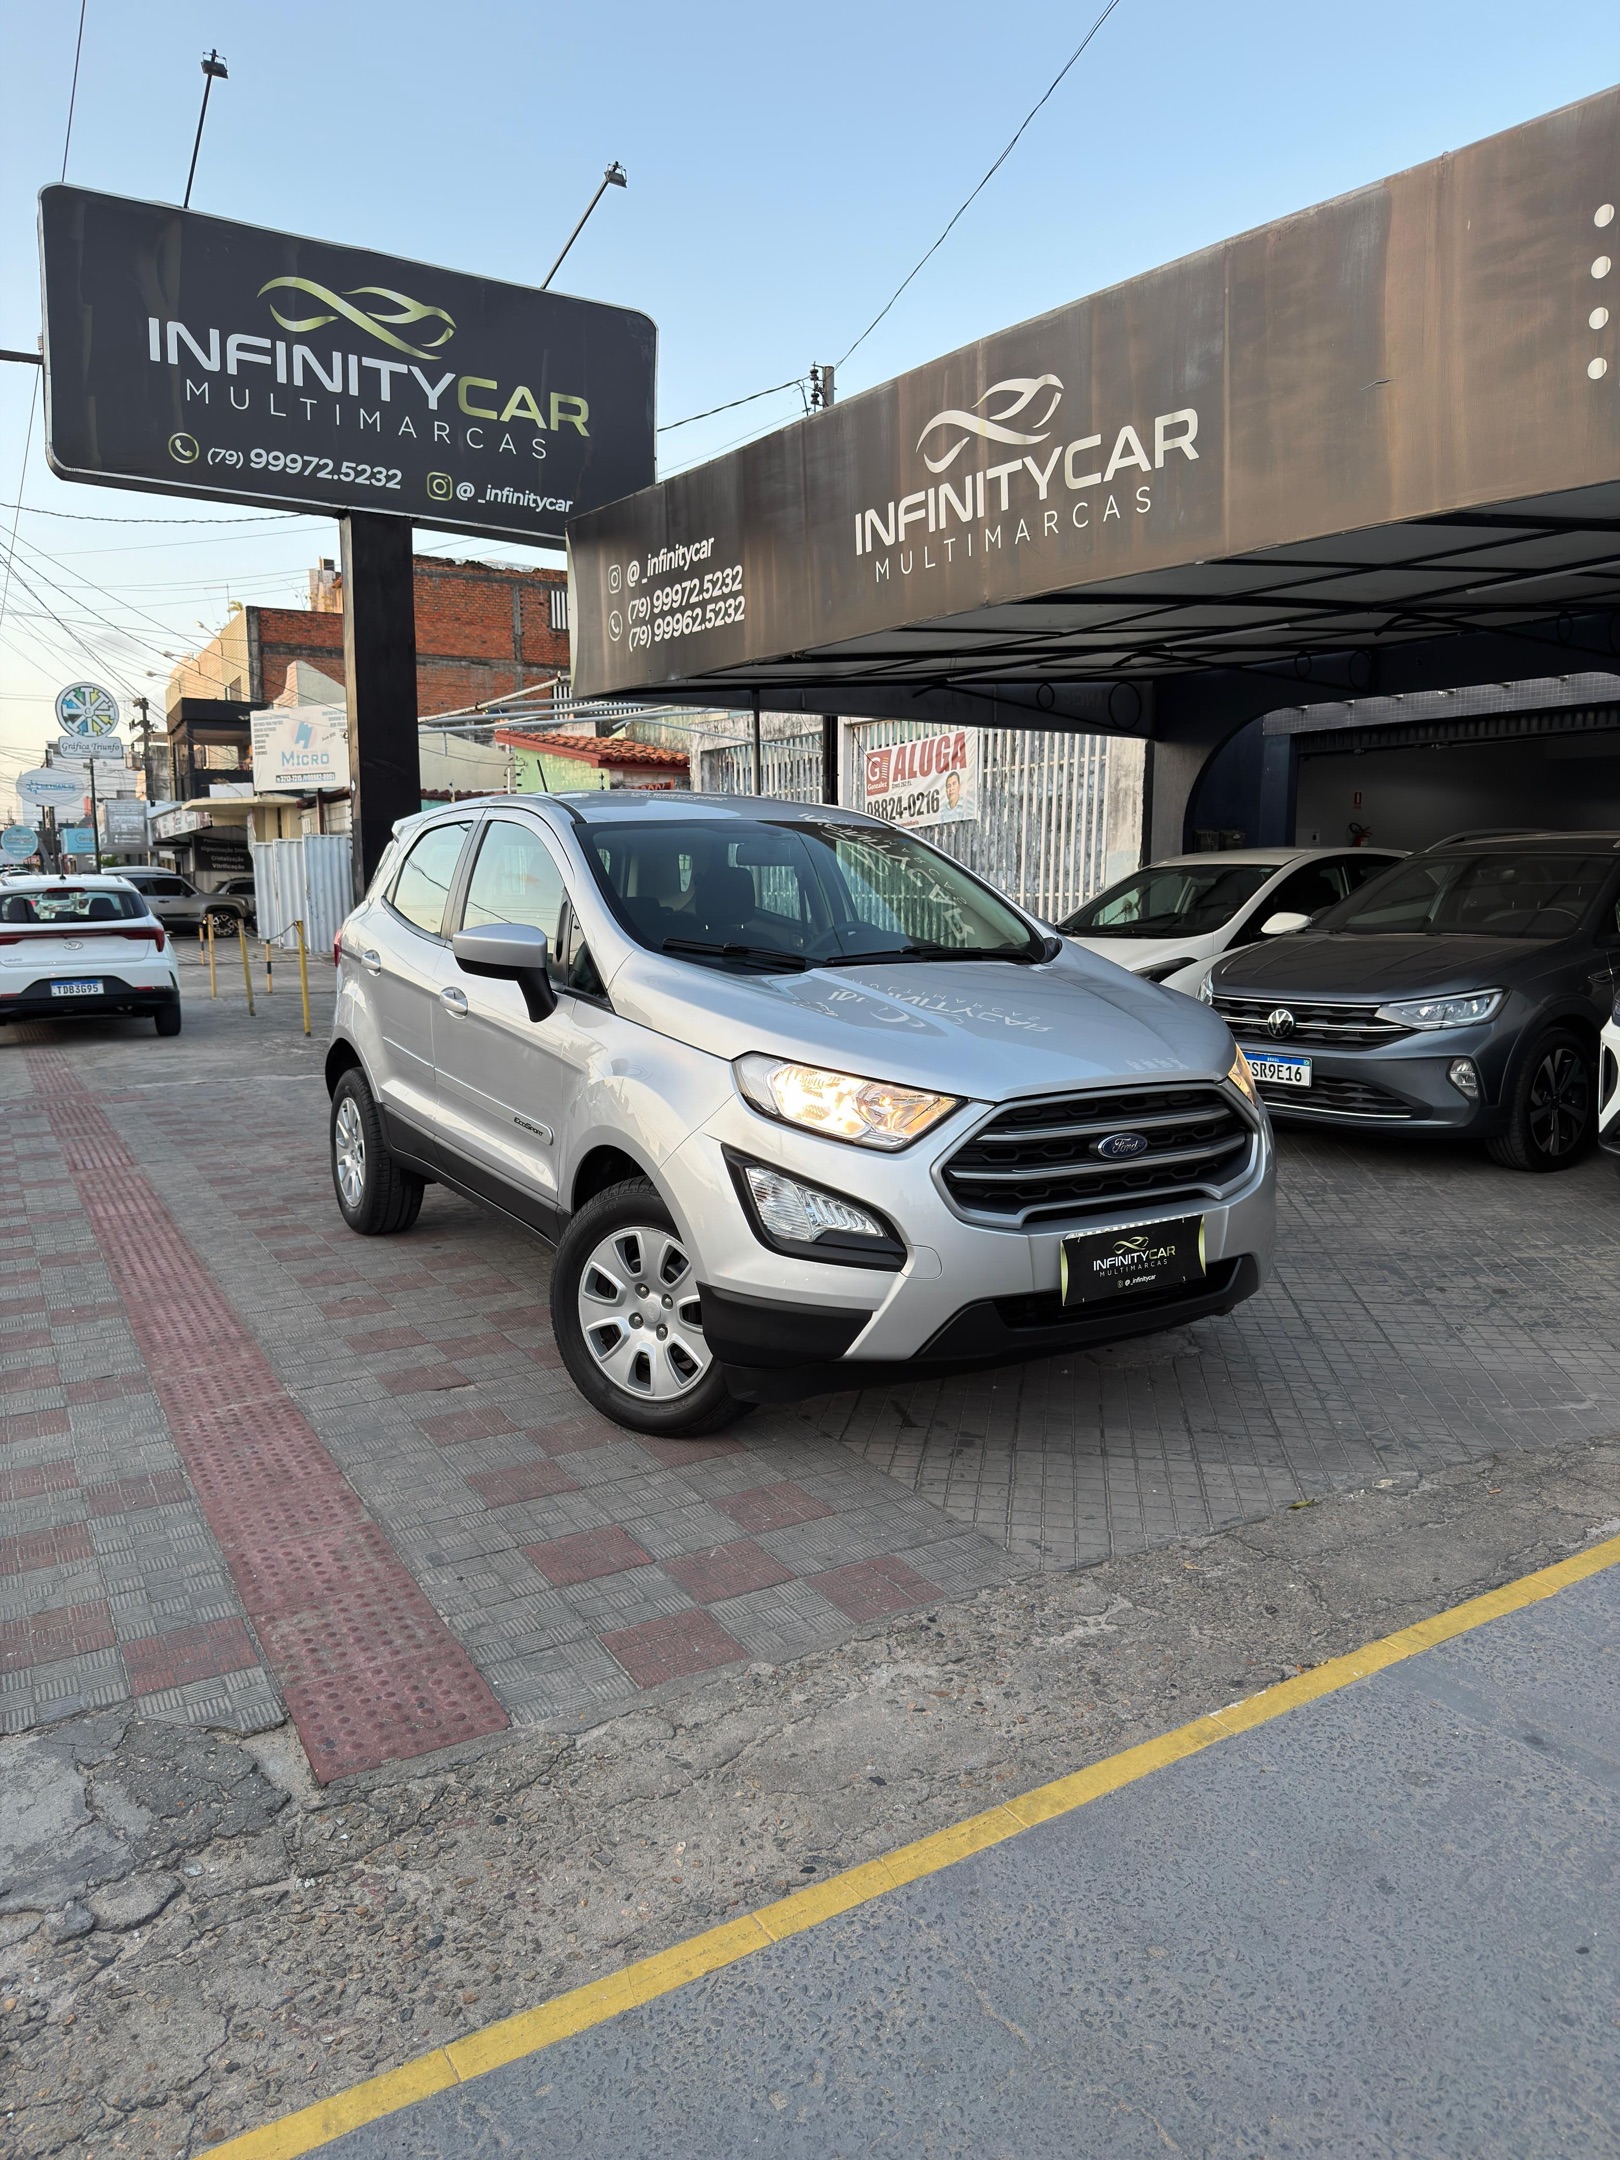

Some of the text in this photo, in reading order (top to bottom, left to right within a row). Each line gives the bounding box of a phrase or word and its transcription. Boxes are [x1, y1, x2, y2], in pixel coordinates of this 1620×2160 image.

[148, 316, 590, 437] INFINITYCAR
[185, 378, 547, 460] MULTIMARCAS
[207, 447, 402, 489] (79) 99972.5232
[855, 408, 1200, 556] INFINITYCAR
[875, 486, 1152, 583] MULTIMARCAS
[627, 565, 743, 625] (79) 99972.5232
[628, 595, 746, 652] (79) 99962.5232
[61, 741, 120, 753] Gráfica Triunfo
[891, 731, 967, 782] ALUGA
[867, 781, 888, 791] Gonzalez
[56, 984, 99, 994] TDB3G95
[1247, 1061, 1302, 1082] SR9E16
[1112, 1137, 1140, 1154] Ford
[1093, 1245, 1176, 1271] INFINITYCAR
[1099, 1259, 1168, 1278] MULTIMARCAS
